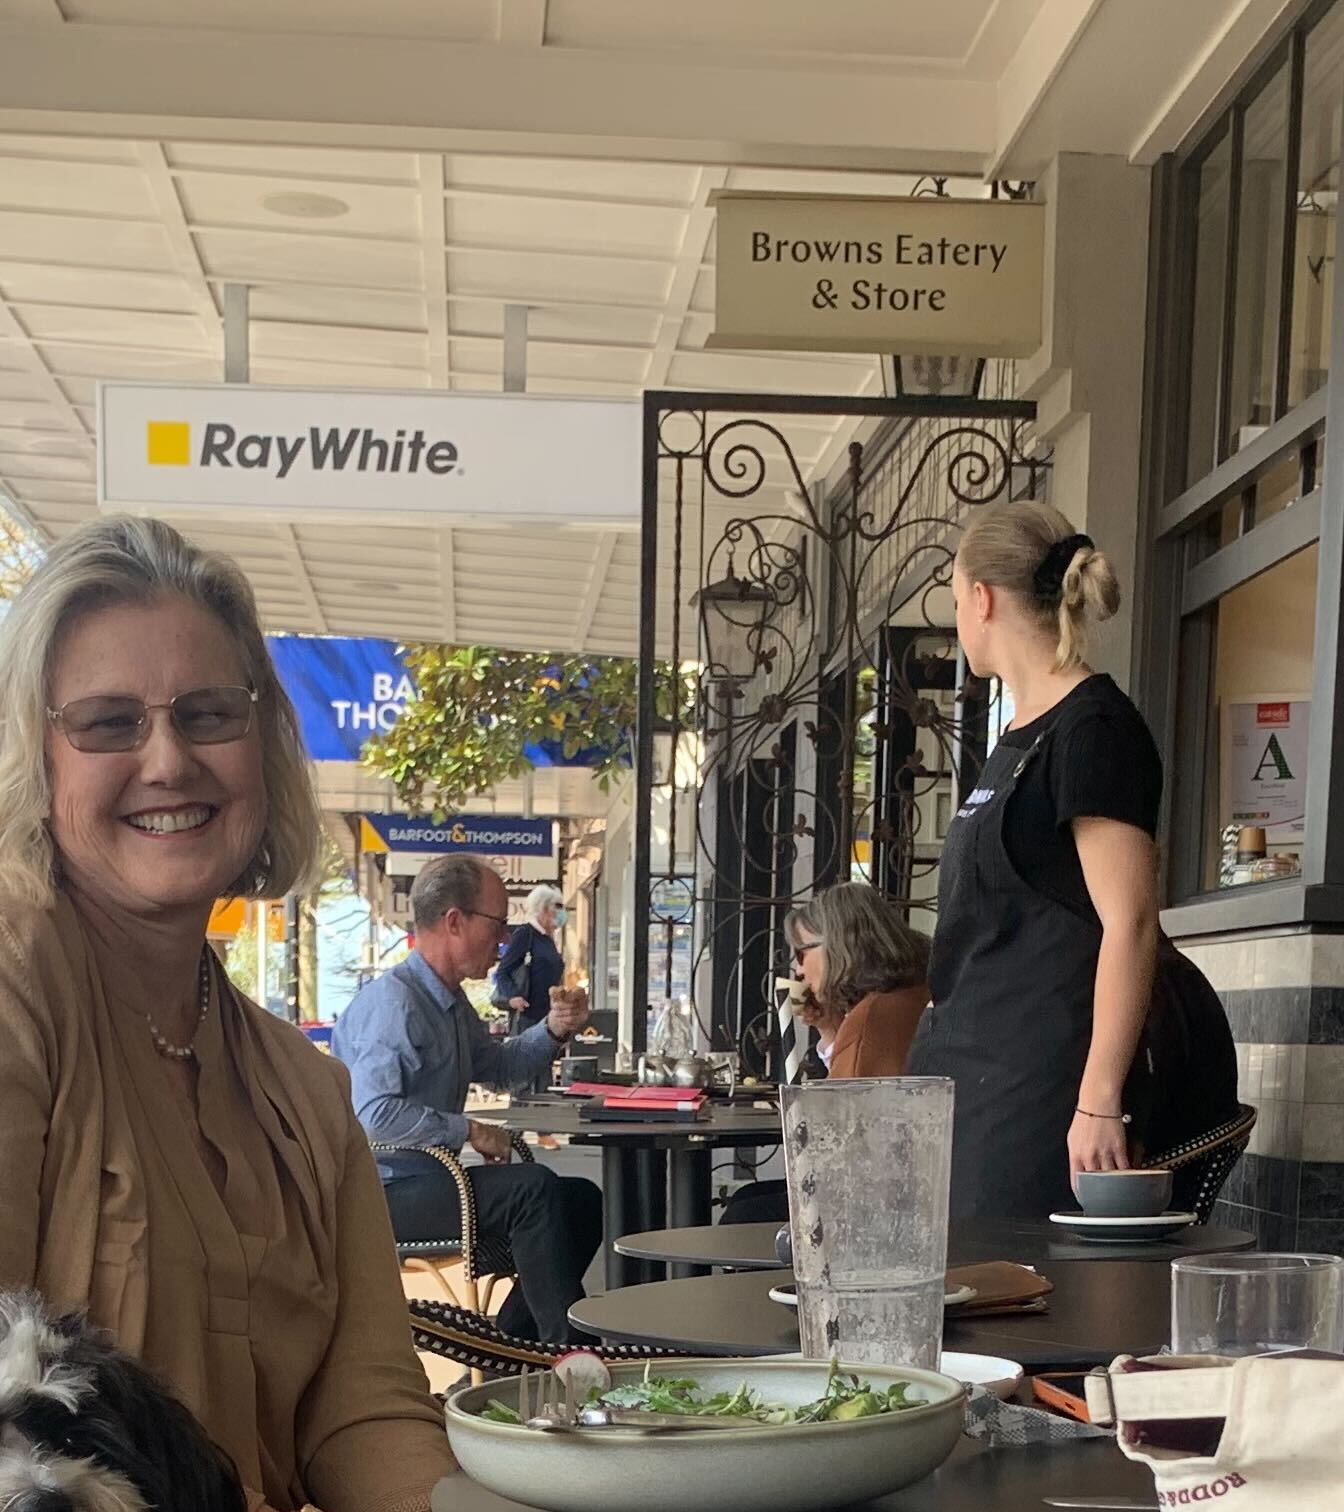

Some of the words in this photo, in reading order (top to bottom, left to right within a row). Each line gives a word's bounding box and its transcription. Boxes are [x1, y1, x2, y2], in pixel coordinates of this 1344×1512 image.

[751, 231, 883, 265] Browns
[895, 233, 1008, 273] Eatery
[811, 278, 839, 309] &
[850, 279, 947, 311] Store
[1251, 732, 1295, 781] A
